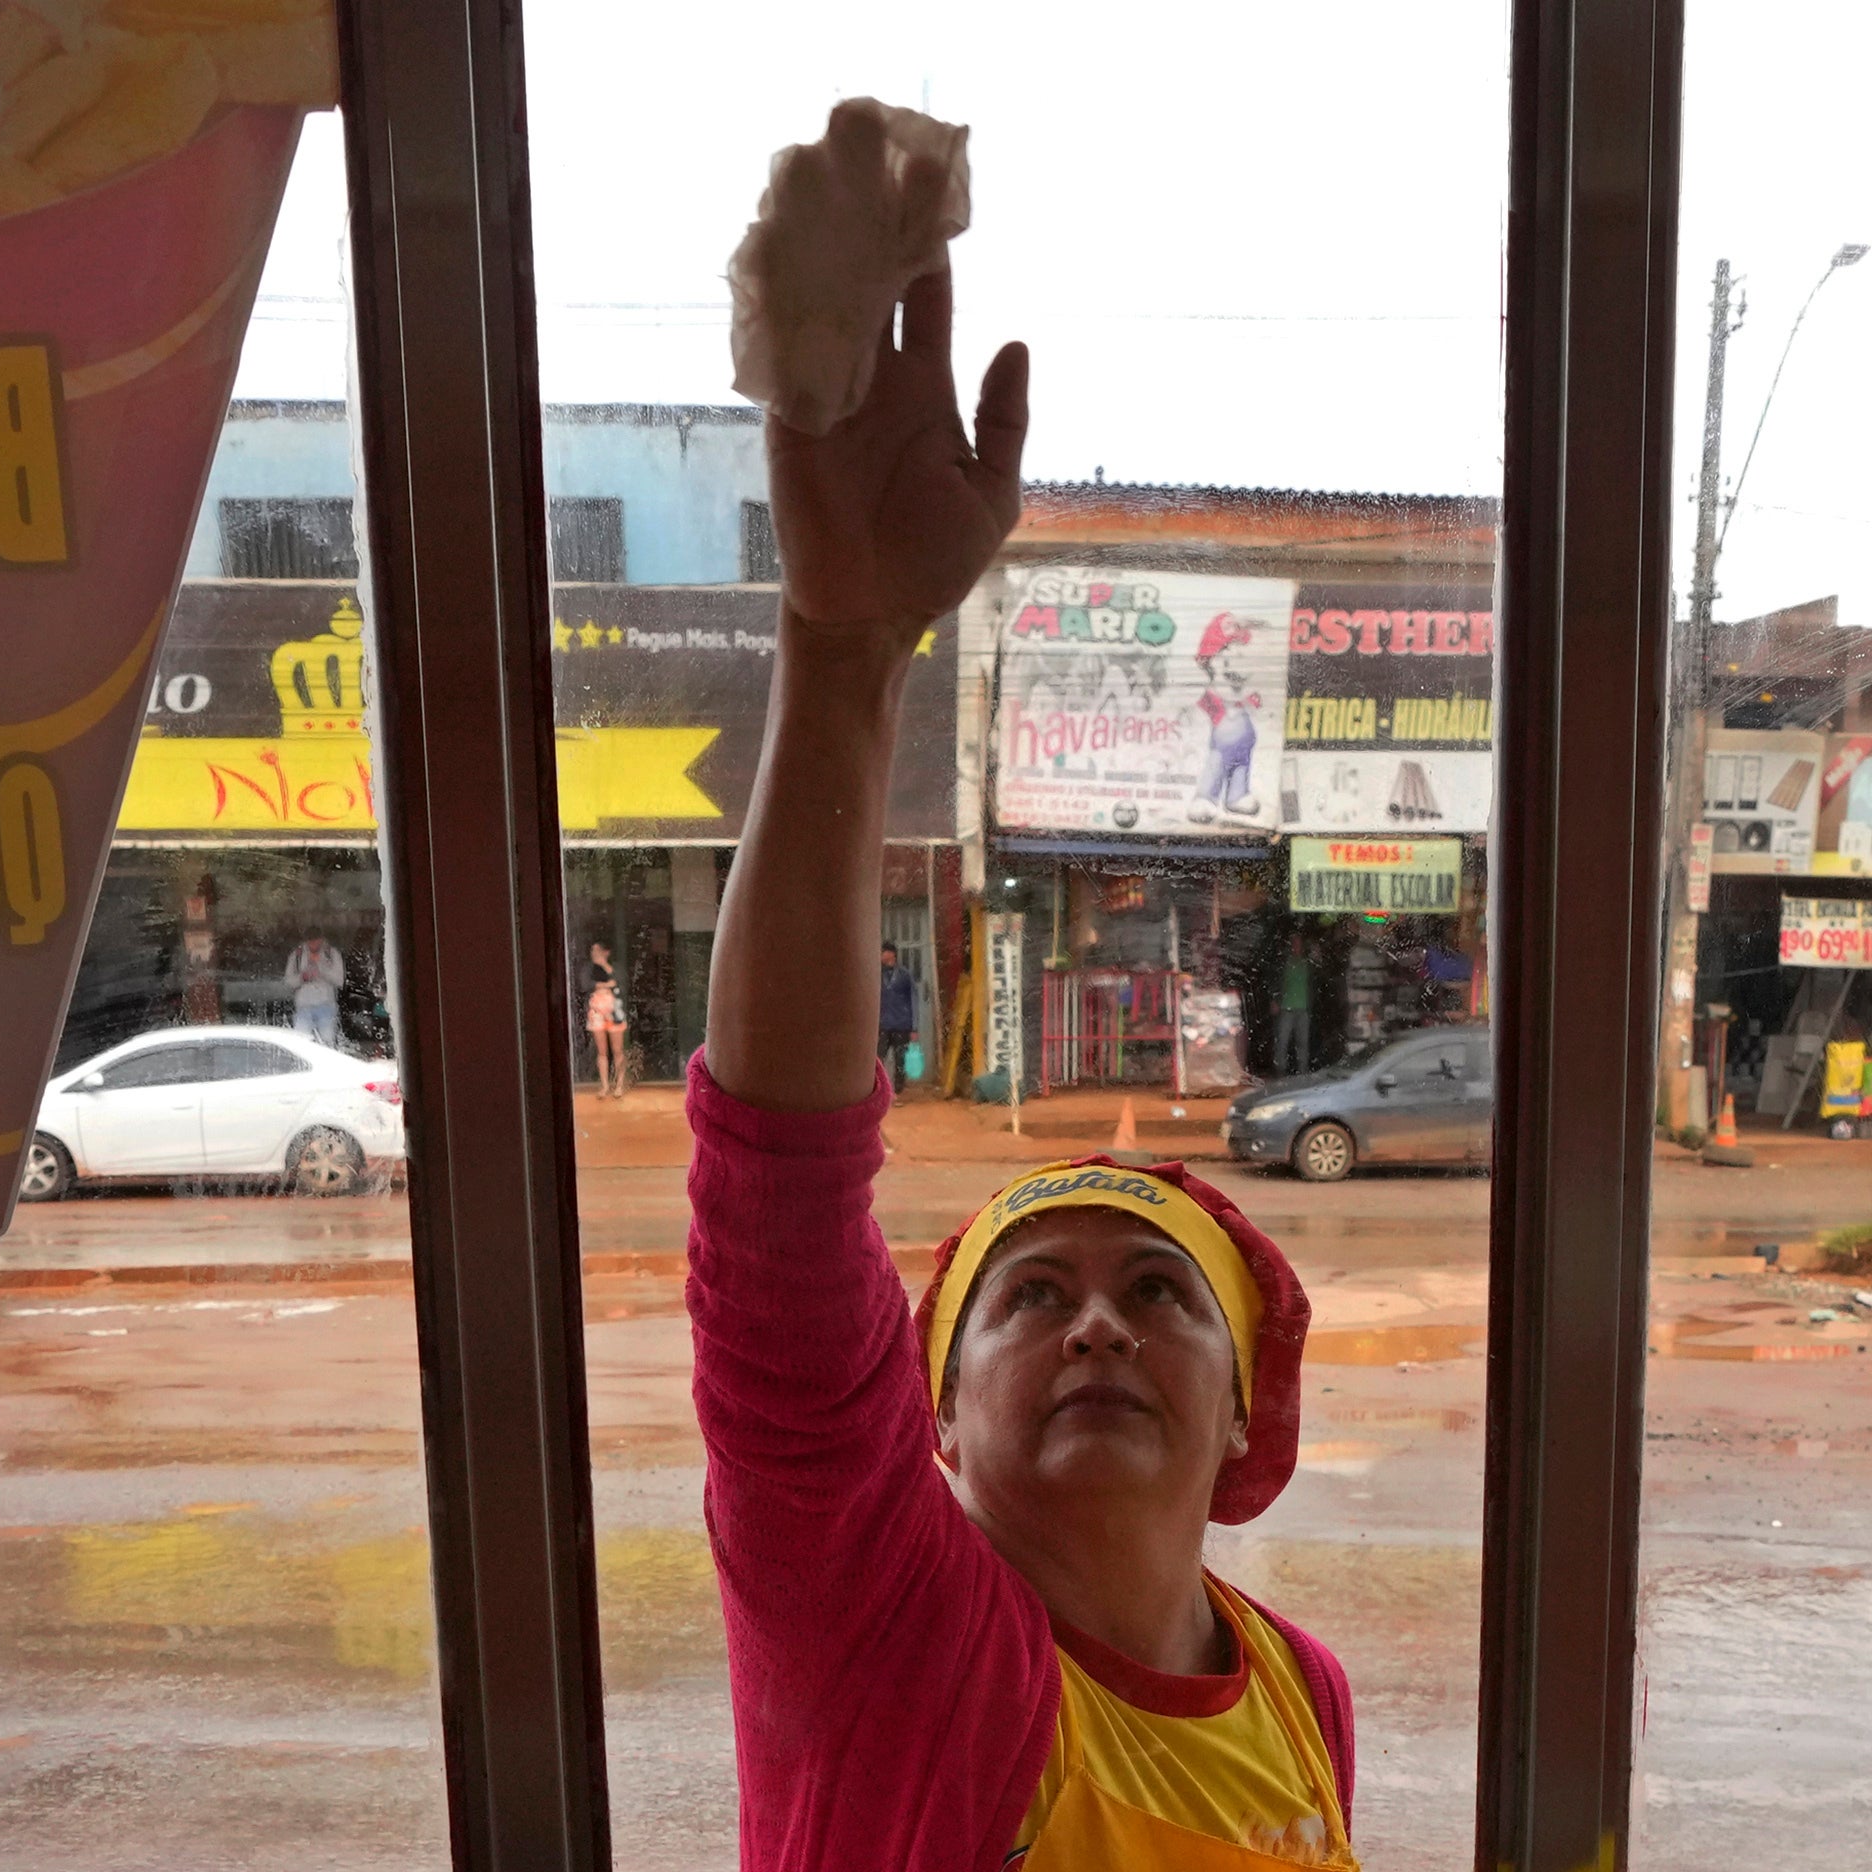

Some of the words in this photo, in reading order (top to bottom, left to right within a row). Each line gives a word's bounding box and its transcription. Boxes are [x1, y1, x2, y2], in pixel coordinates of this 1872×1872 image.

[1032, 577, 1160, 611] SUPER
[1011, 604, 1177, 646] MARIO
[1007, 699, 1183, 767] havaianas
[205, 745, 374, 822] No
[1005, 1170, 1168, 1213] Batata
